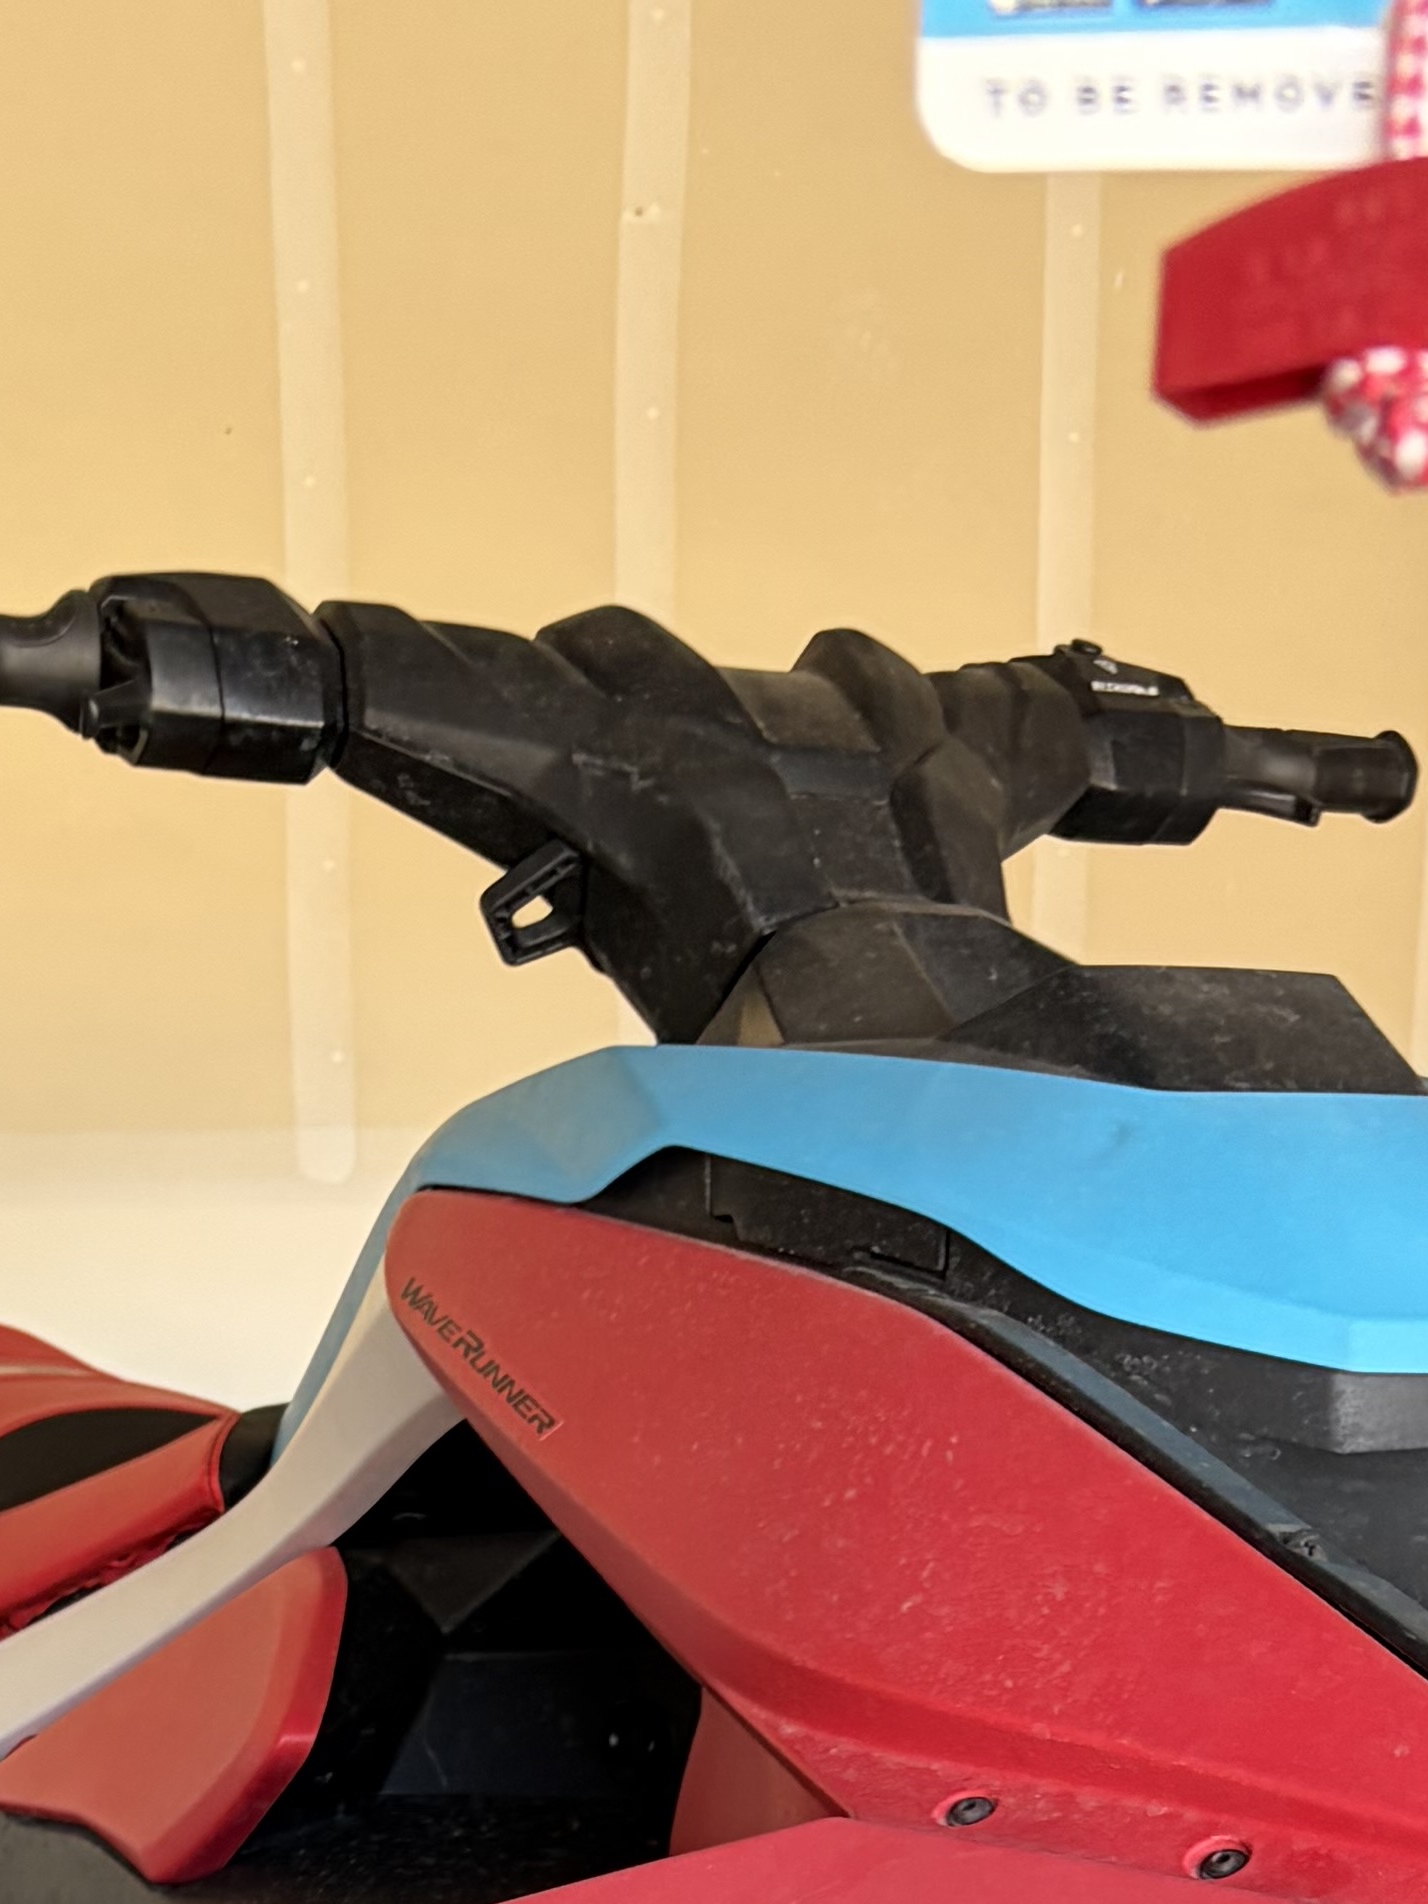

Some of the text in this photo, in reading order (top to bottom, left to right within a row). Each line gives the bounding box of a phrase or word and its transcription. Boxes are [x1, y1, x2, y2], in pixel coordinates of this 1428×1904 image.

[984, 77, 1048, 117] TO
[1076, 75, 1138, 115] BE
[1164, 73, 1375, 114] REMOVE
